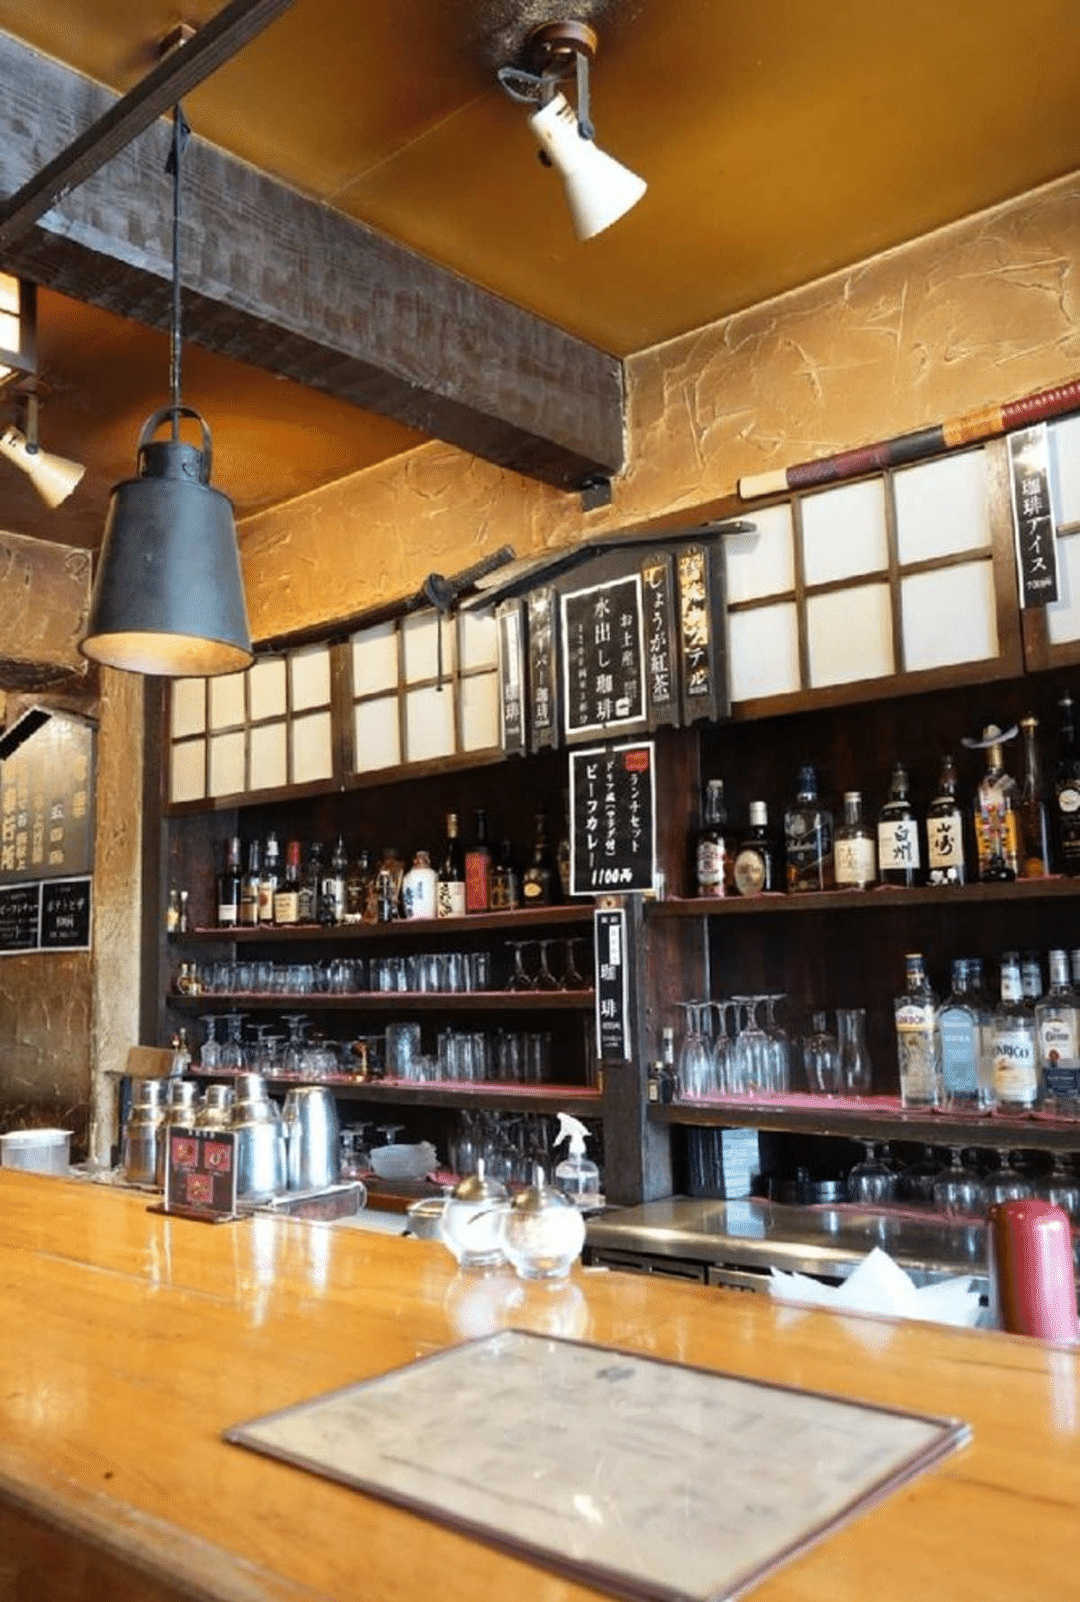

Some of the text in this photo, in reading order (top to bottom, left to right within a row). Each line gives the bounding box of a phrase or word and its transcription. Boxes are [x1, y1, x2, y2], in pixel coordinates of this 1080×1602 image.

[594, 597, 614, 721] 水出し珈琲
[649, 569, 668, 694] しょうが紅茶
[585, 763, 598, 868] ビーフカレー
[629, 773, 642, 853] ランチセット
[894, 824, 912, 862] 白州
[935, 823, 955, 856] 山崎
